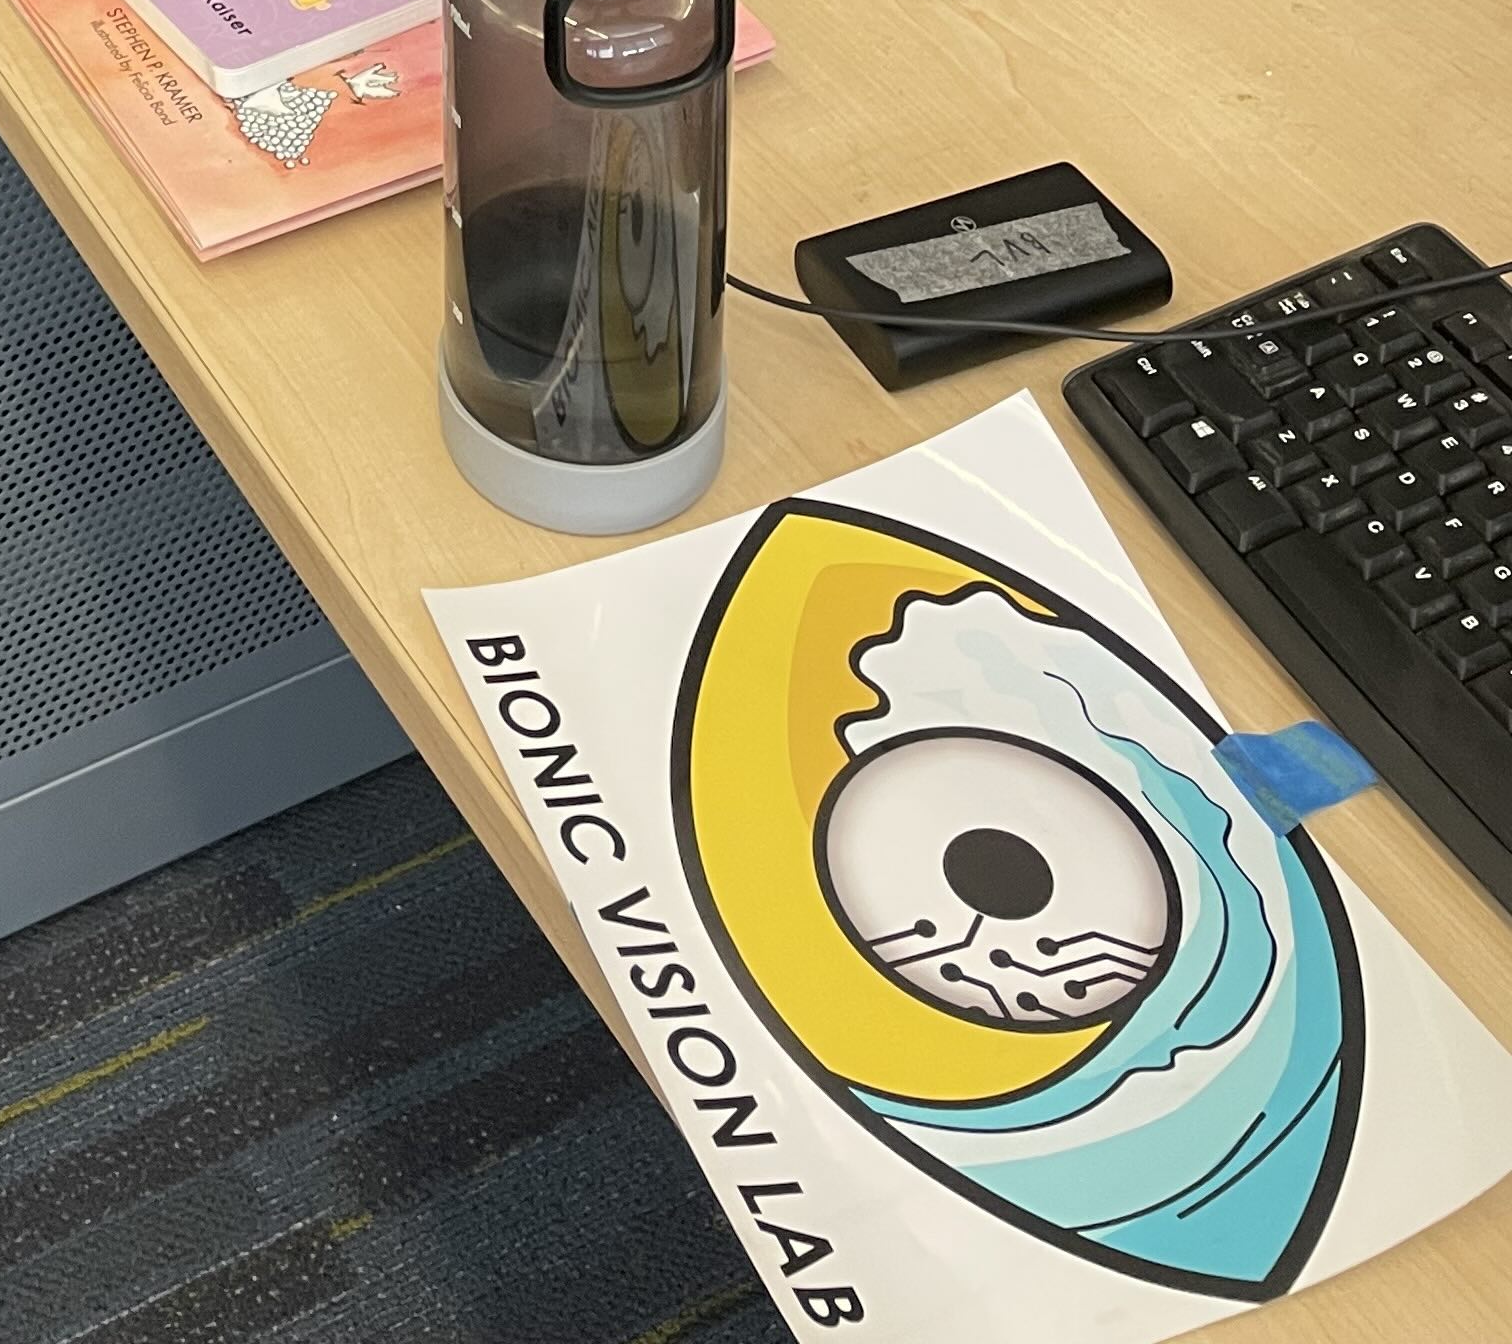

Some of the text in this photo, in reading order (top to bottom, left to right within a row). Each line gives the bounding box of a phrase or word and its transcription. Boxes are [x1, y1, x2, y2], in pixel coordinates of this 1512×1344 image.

[106, 7, 203, 123] STEPHEN P. KRAMER
[120, 60, 133, 72] by
[150, 101, 178, 126] Bond
[1138, 358, 1157, 374] Ctrl
[1353, 353, 1368, 366] Q
[1408, 358, 1422, 368] 2
[1310, 388, 1325, 399] A
[1398, 394, 1416, 408] W
[1454, 400, 1469, 410] 3
[1279, 430, 1295, 443] Z
[1354, 429, 1370, 440] S
[1441, 437, 1458, 448] E
[1248, 477, 1266, 490] Alt
[1321, 475, 1339, 487] X
[1399, 472, 1415, 484] D
[1488, 481, 1505, 494] R
[1368, 521, 1384, 533] C
[1445, 518, 1462, 527] F
[1415, 567, 1431, 579] V
[1495, 566, 1511, 579] G
[1461, 616, 1479, 629] B
[464, 634, 866, 1329] BIONIC VISION LAB
